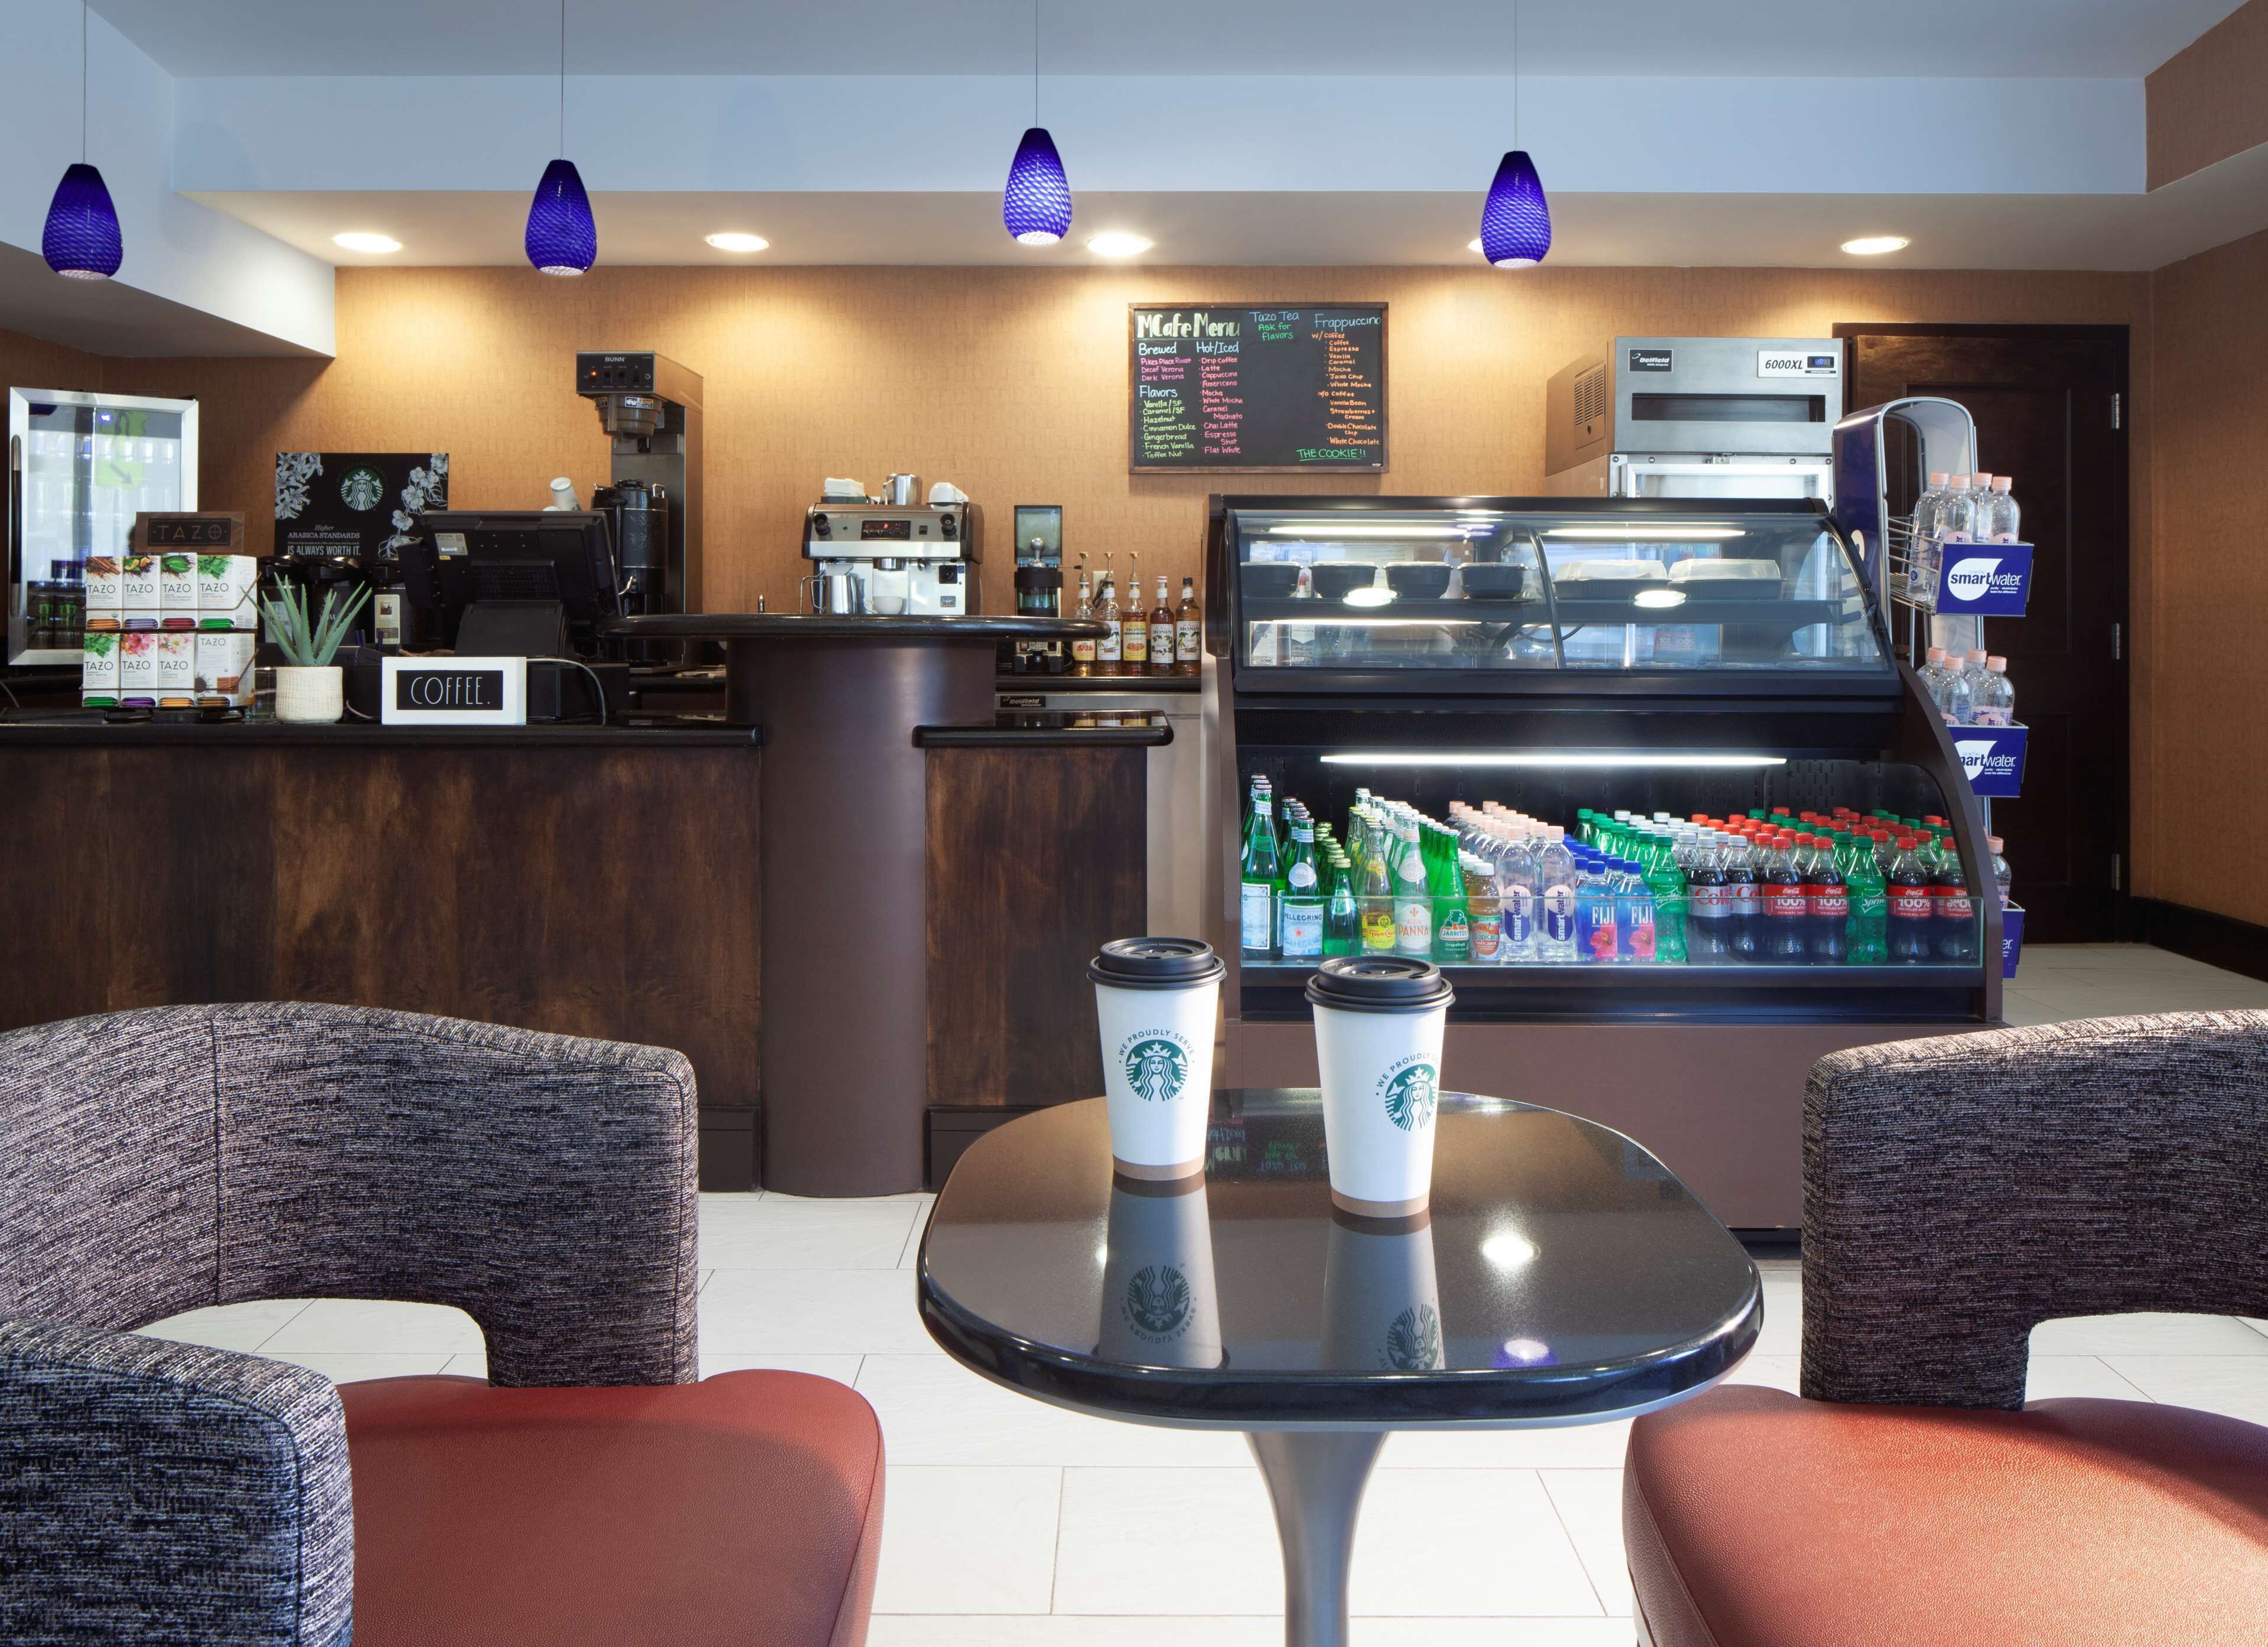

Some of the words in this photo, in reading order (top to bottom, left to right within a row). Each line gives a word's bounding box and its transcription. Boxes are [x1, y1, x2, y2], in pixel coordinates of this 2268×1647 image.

[1249, 312, 1276, 323] Tazo
[1278, 311, 1299, 321] Tea
[1194, 313, 1240, 337] Menu
[1315, 314, 1381, 332] Frappuccino
[1262, 332, 1293, 341] flavors
[1139, 341, 1177, 355] Brewed
[1765, 360, 1803, 369] 6000XL
[1139, 385, 1178, 398] Flavors
[1144, 433, 1187, 443] Gingerbread
[1296, 449, 1316, 458] THE
[157, 525, 222, 539] TAZO
[288, 546, 294, 555] IS
[296, 545, 324, 555] ALWAYS
[326, 545, 351, 555] WORTH
[87, 585, 116, 594] TAZO
[125, 584, 154, 593] TAZO
[162, 584, 191, 593] TAZO
[200, 583, 229, 592] TAZO
[200, 638, 226, 646] TAZO
[84, 661, 113, 670] TAZO
[122, 660, 151, 670] TAZO
[159, 661, 188, 670] TAZO
[1775, 896, 1805, 906] 100%
[1898, 897, 1930, 908] 100%
[1592, 906, 1614, 925] FIJI
[1631, 906, 1653, 925] FIJI
[1399, 923, 1429, 936] PANNA
[1119, 1043, 1128, 1056] WE
[1128, 1029, 1171, 1043] PROUDLY
[1174, 1033, 1195, 1055] SERVE
[1377, 1073, 1389, 1088] WE
[1390, 1052, 1430, 1072] PROUDLY
